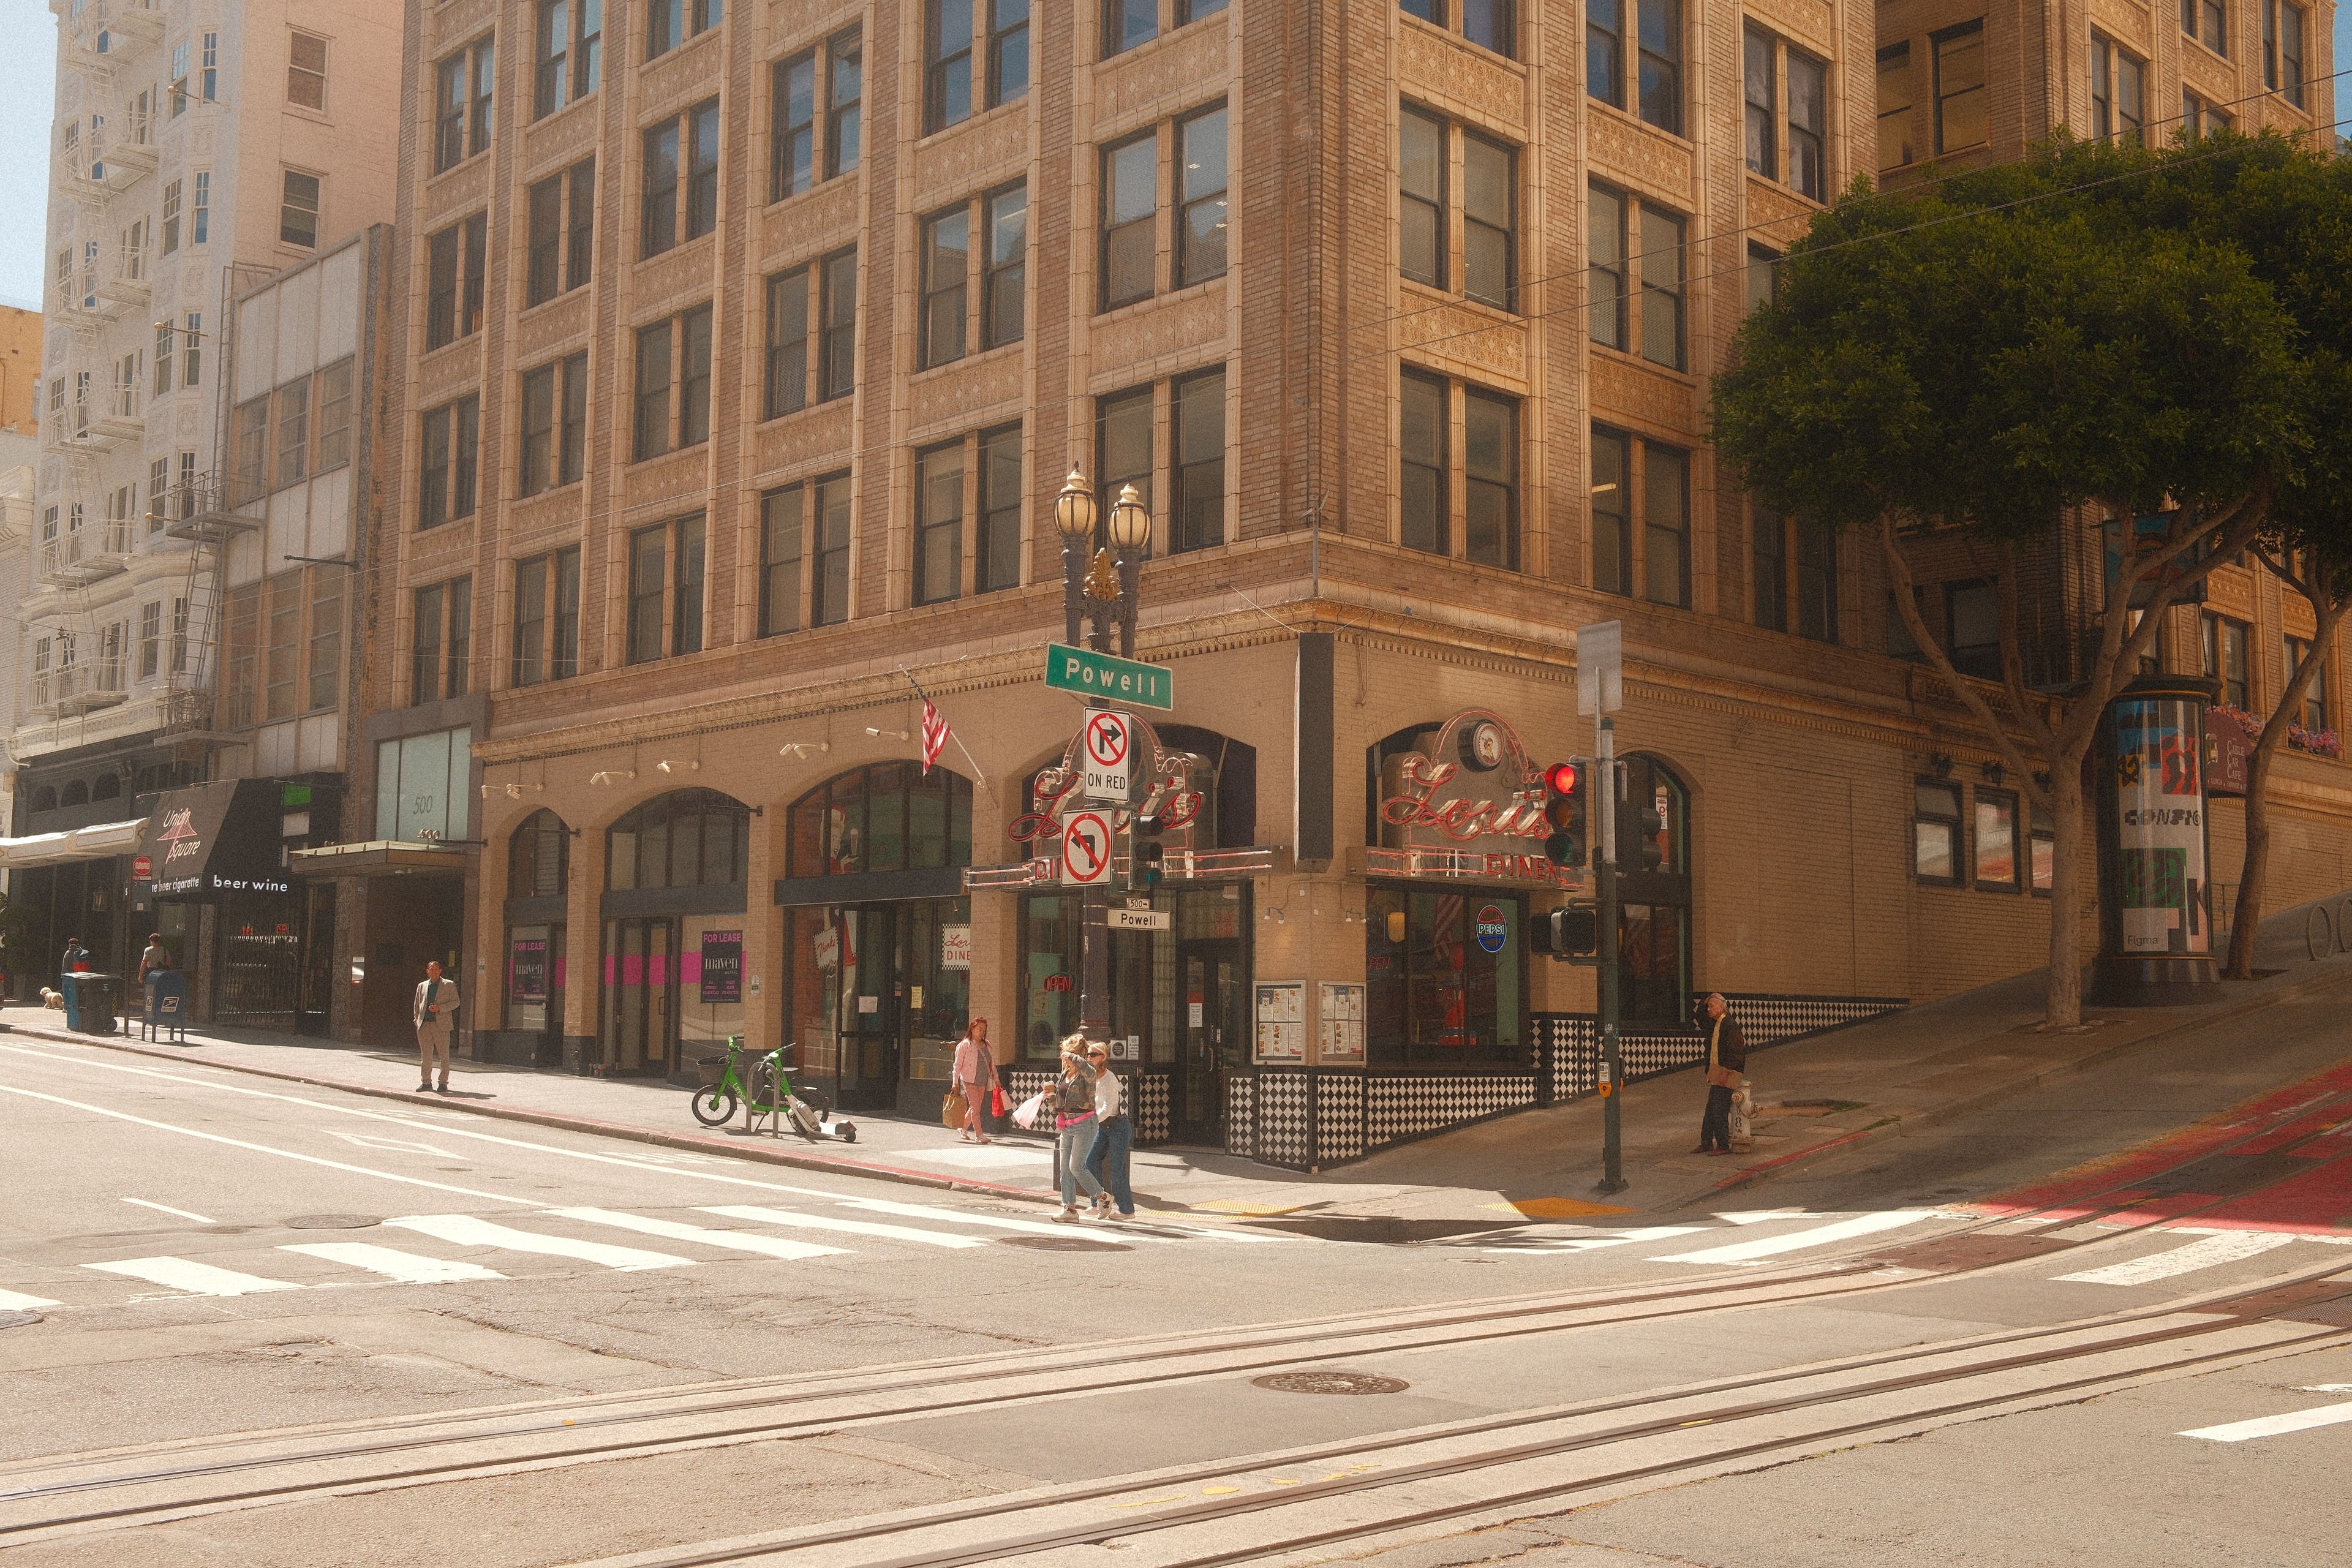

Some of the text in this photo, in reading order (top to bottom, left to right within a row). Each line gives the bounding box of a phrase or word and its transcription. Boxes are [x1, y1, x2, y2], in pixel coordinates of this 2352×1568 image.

[1066, 657, 1155, 696] Powell
[1088, 772, 1126, 790] ON RED
[413, 795, 433, 815] 500
[164, 808, 191, 828] Union
[418, 829, 440, 840] 500
[170, 840, 201, 862] Square
[1485, 854, 1558, 879] DINER
[158, 879, 172, 892] beer
[172, 876, 200, 893] cigarette
[214, 875, 288, 892] beer wine
[1121, 913, 1156, 927] Powell
[703, 932, 742, 943] FOR LEASE
[1479, 924, 1505, 935] PEPSI
[527, 941, 546, 951] LEASE
[2127, 935, 2158, 946] Figma
[516, 964, 543, 975] maven
[705, 957, 738, 970] maven
[1043, 975, 1071, 993] OPEN
